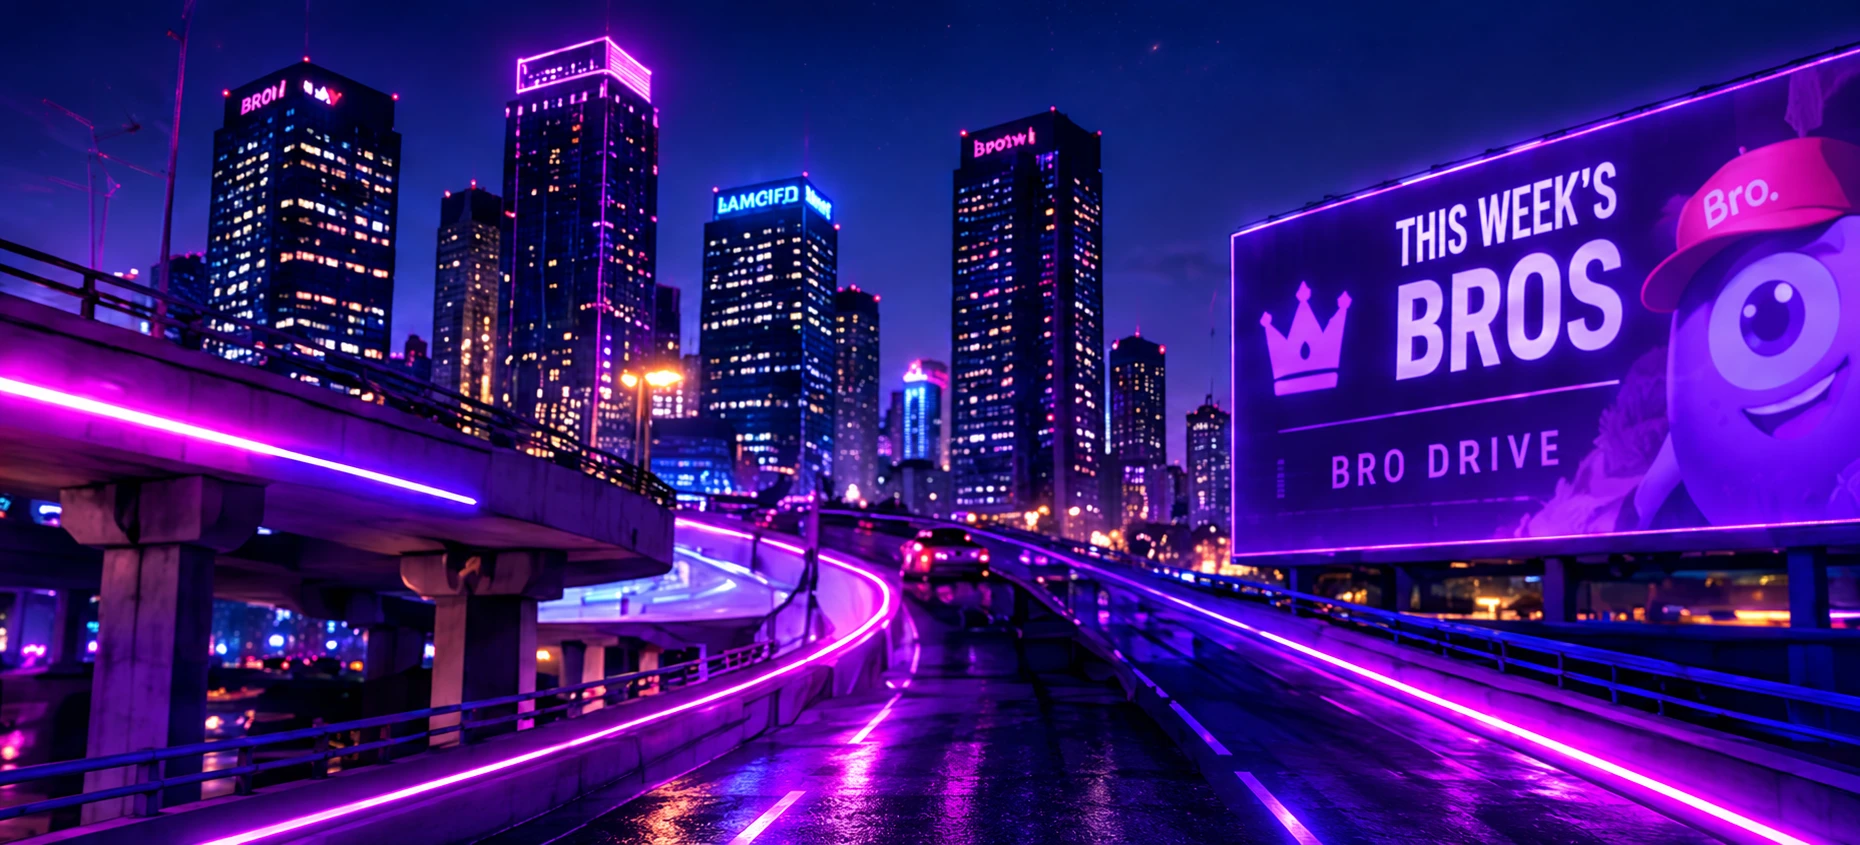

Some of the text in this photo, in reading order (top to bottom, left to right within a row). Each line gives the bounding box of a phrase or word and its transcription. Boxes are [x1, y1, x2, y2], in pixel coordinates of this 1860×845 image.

[1396, 161, 1617, 267] THIS WEEK’S
[1703, 179, 1779, 229] Bro.
[1396, 239, 1623, 381] BROS
[1331, 429, 1560, 489] BRO DRIVE
